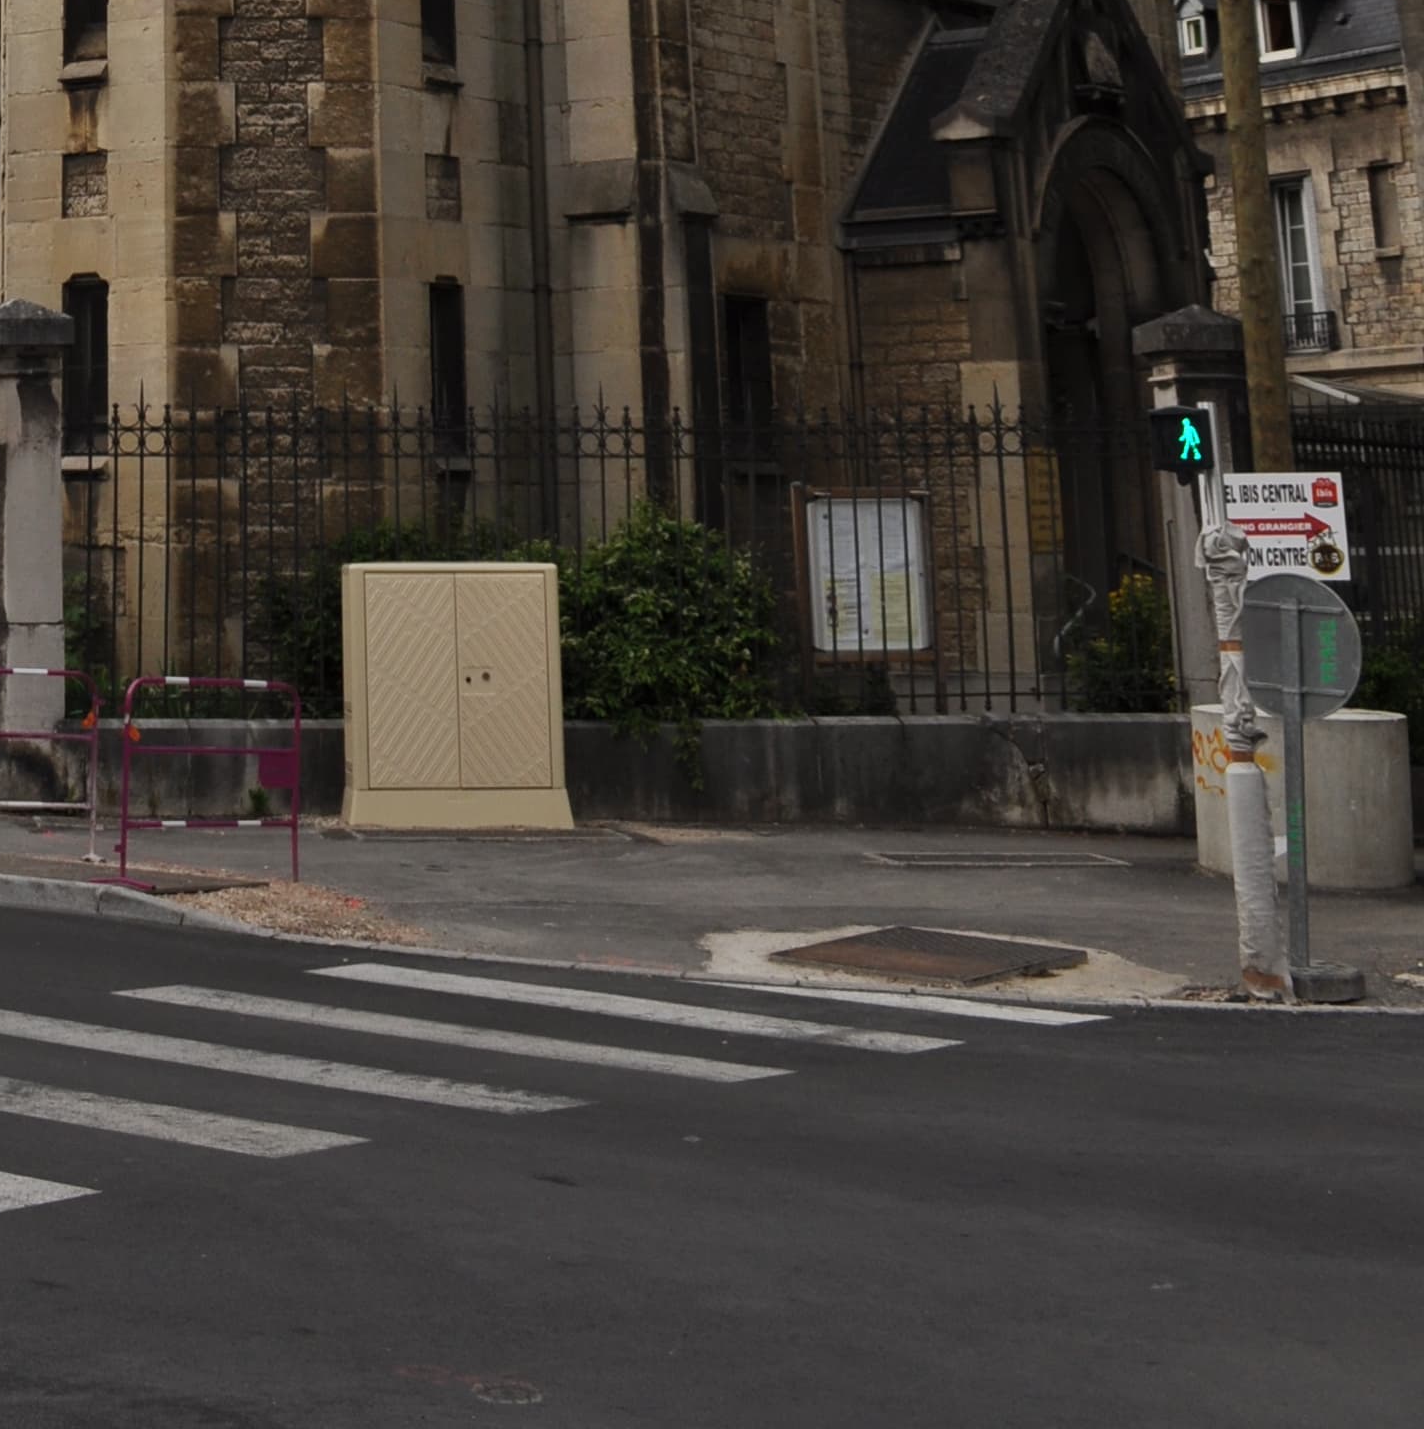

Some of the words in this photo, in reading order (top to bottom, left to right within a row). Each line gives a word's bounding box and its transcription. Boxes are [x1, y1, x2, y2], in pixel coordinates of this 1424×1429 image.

[1239, 485, 1259, 503] IBIS
[1262, 484, 1308, 503] CENTRAL
[1258, 522, 1312, 532] GRANGIER
[1266, 547, 1307, 566] CENTRE
